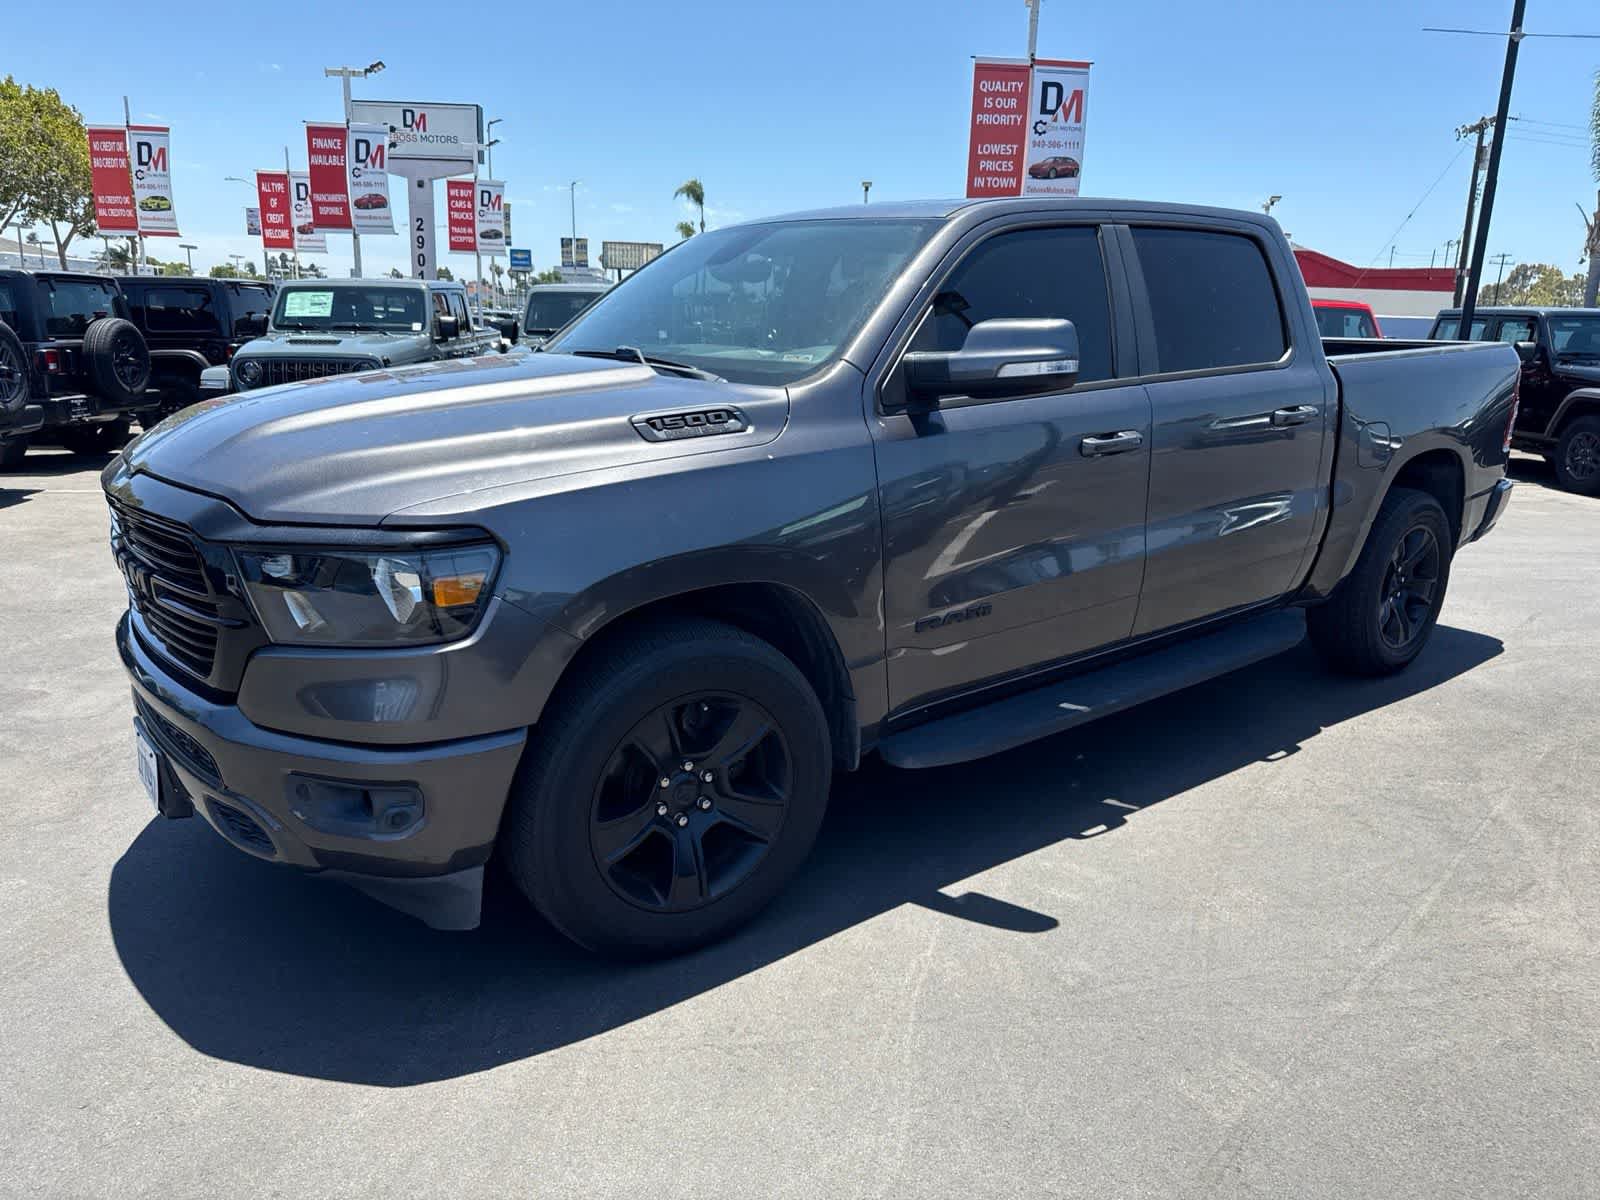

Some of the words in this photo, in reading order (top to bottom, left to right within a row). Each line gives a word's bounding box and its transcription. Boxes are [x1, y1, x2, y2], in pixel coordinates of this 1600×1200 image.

[979, 80, 1024, 93] QUALITY
[983, 97, 993, 109] IS
[995, 98, 1017, 109] OUR
[976, 114, 1023, 126] PRIORITY
[312, 138, 342, 150] FINANCE
[420, 134, 459, 144] MOTORS
[977, 143, 1018, 155] LOWEST
[310, 154, 345, 166] AVAILABLE
[979, 160, 1014, 172] PRICES
[261, 181, 271, 193] ALL
[272, 182, 285, 193] TYPE
[974, 177, 985, 188] IN
[986, 177, 1017, 189] TOWN
[449, 188, 459, 197] WE
[460, 189, 473, 198] BUY
[269, 197, 278, 208] OF
[450, 200, 467, 209] CARS
[266, 213, 285, 224] CREDIT
[450, 211, 473, 220] TRUCKS
[264, 228, 290, 240] WELCOME
[647, 410, 729, 432] 1500
[914, 601, 993, 633] RAM
